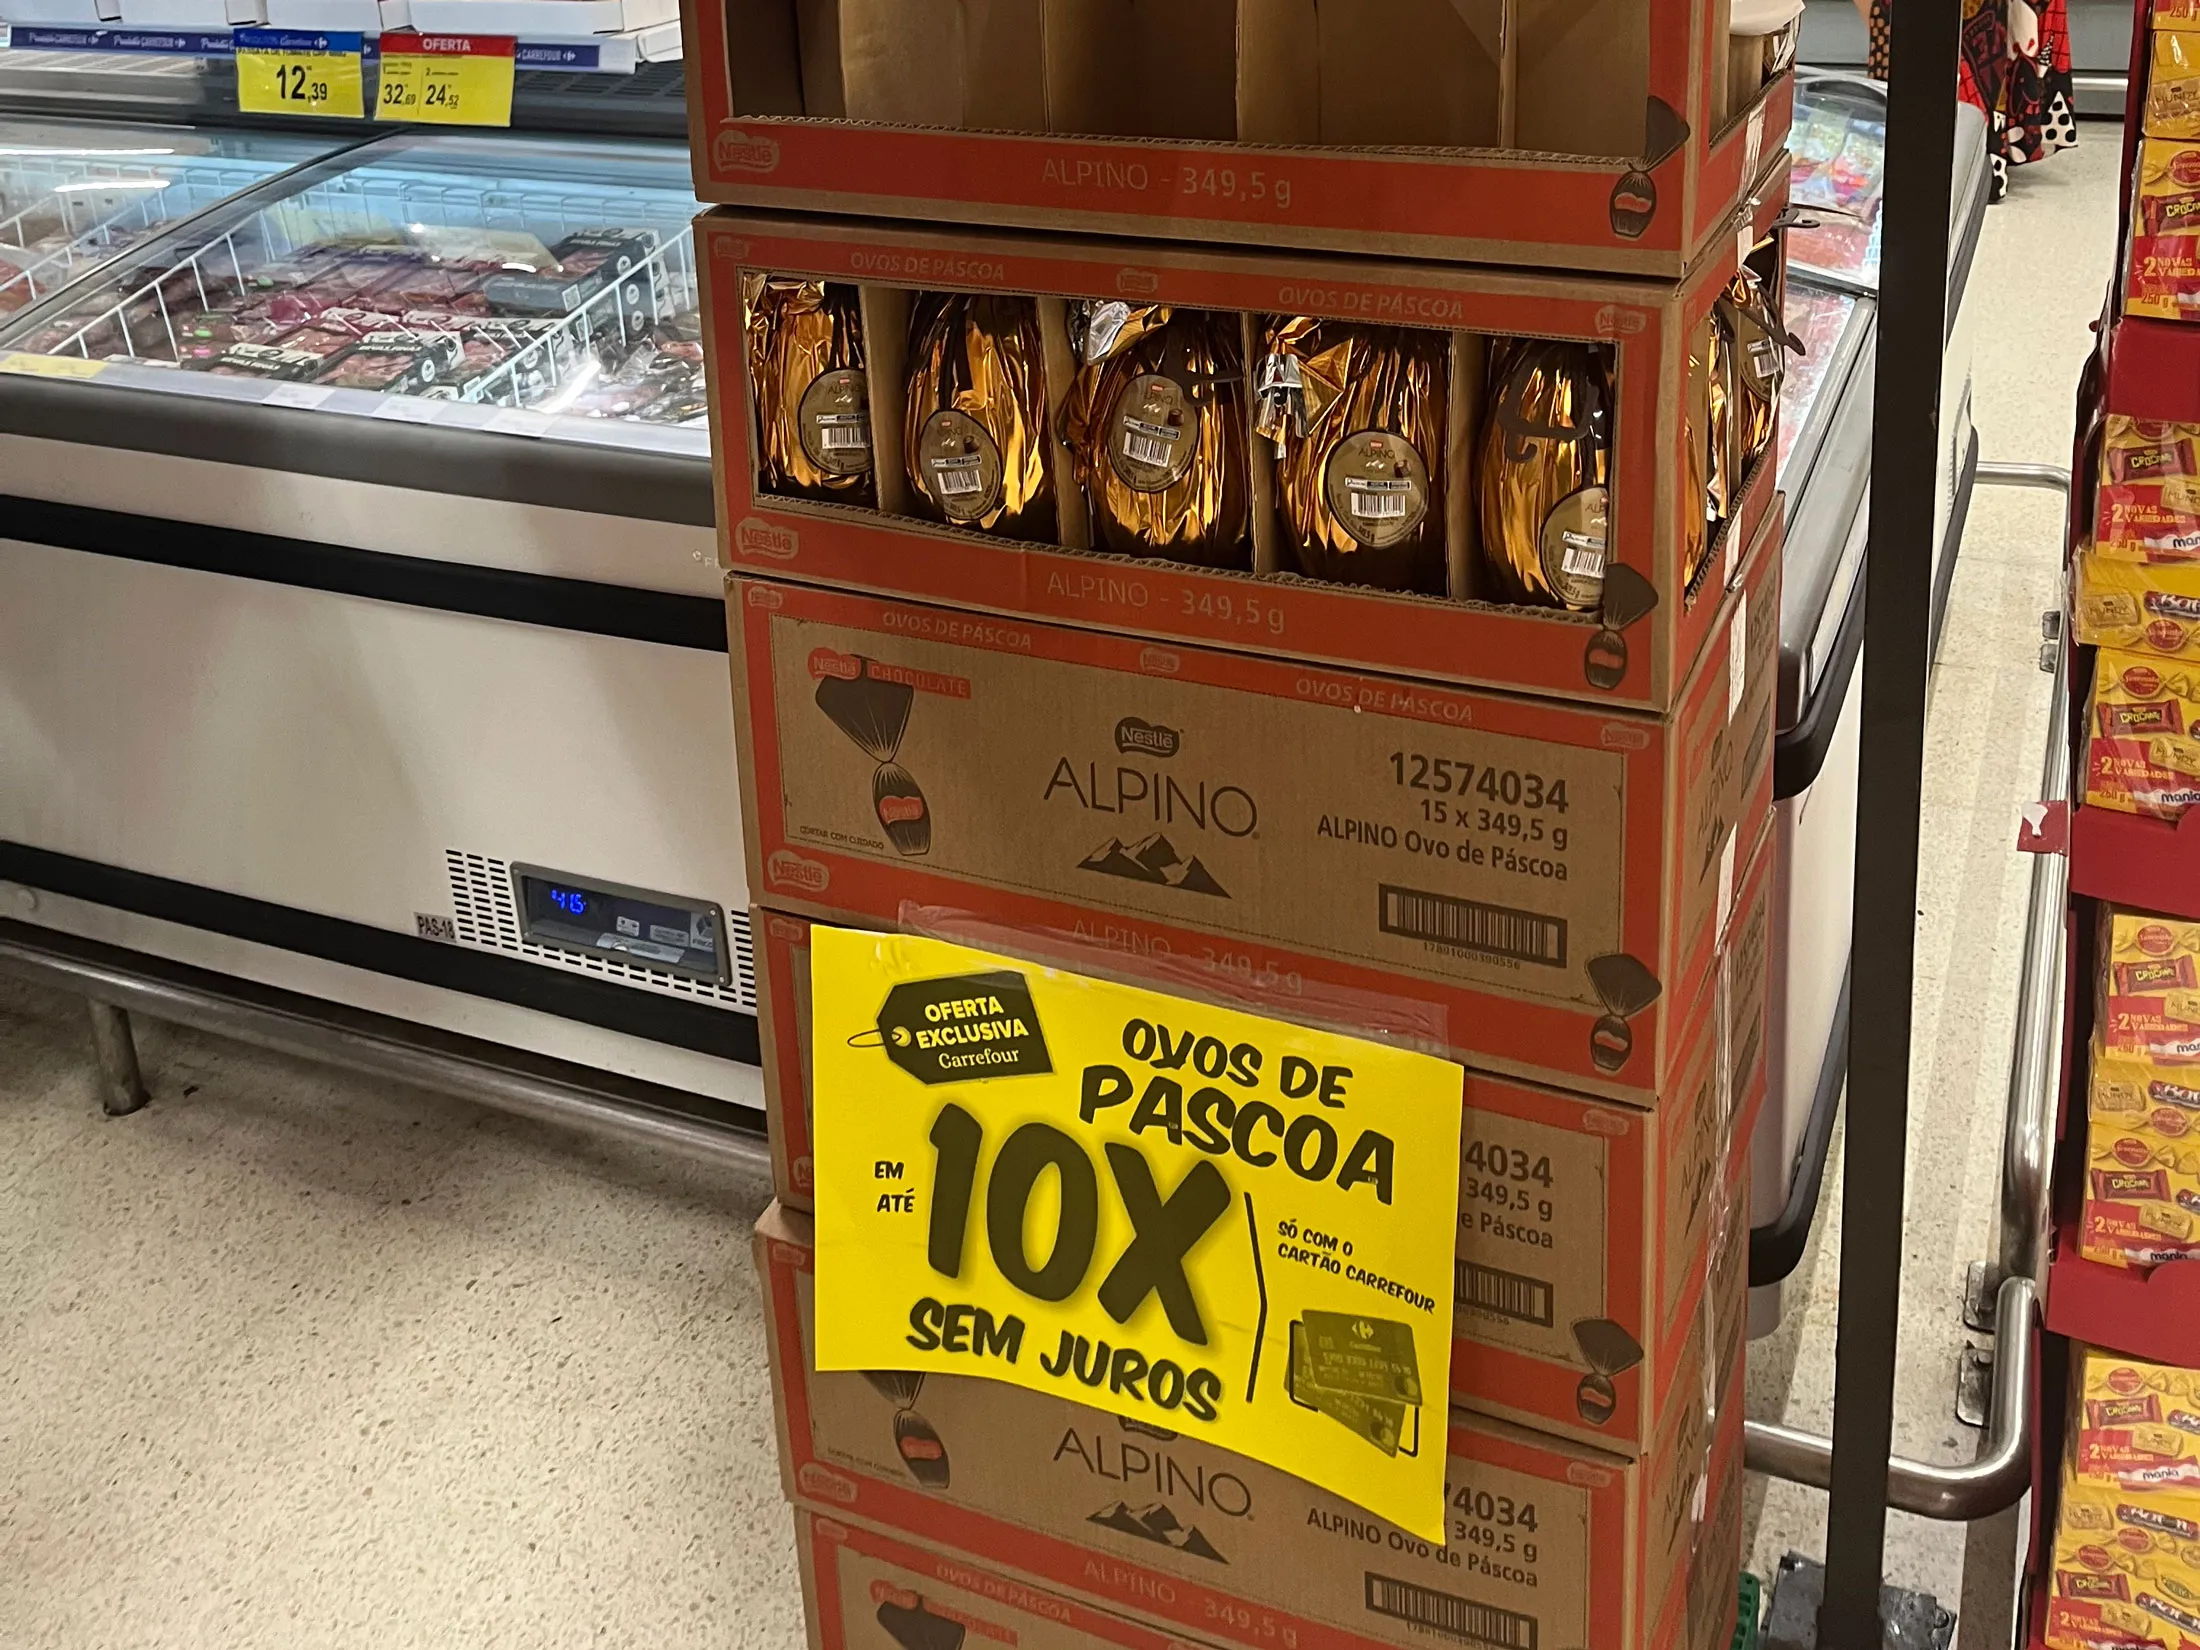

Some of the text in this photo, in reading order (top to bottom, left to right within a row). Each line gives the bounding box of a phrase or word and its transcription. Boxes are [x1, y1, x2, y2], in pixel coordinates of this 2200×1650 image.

[423, 39, 471, 51] OFERTA
[1042, 158, 1148, 190] ALPINO
[1182, 167, 1265, 201] 349,5
[1275, 178, 1291, 208] g
[850, 251, 900, 273] OVOS
[906, 256, 929, 275] DE
[2143, 256, 2157, 277] 2
[1278, 286, 1337, 307] OVOS
[1343, 292, 1373, 312] DE
[2112, 504, 2124, 522] 2
[1047, 571, 1149, 607] ALPINO
[1181, 589, 1261, 626] 349,5
[1269, 604, 1285, 634] g
[883, 610, 1032, 649] OVOS DE PÁSCOA
[870, 664, 967, 694] CHOCOLATE
[1296, 677, 1352, 701] OVOS
[1359, 686, 1385, 708] DE
[1390, 752, 1569, 813] 12574034
[2101, 756, 2114, 775] 2
[1044, 755, 1257, 838] ALPINO
[1421, 799, 1568, 851] 15 x 349,5 g
[1317, 815, 1568, 881] ALPINO Ovo de Páscoa
[924, 996, 1004, 1022] OFERTA
[2118, 1013, 2131, 1030] 2
[917, 1017, 1028, 1050] EXCLUSIVA
[938, 1045, 1020, 1070] Carrefour
[1122, 1018, 1354, 1109] OVOS DE
[1079, 1064, 1395, 1206] PASCOA
[875, 1161, 904, 1180] EM
[1461, 1139, 1554, 1188] 4034
[876, 1189, 915, 1214] ATÉ
[1466, 1178, 1553, 1222] 349,5 g
[928, 1102, 1232, 1346] 10X
[1277, 1218, 1353, 1257] SÓ COM O
[1481, 1212, 1553, 1249] Páscoa
[2095, 1216, 2106, 1233] 2
[1277, 1243, 1436, 1314] CARTÃO CARREFOUR
[905, 1297, 1222, 1421] SEM JUROS
[2089, 1443, 2101, 1460] 2
[1053, 1427, 1252, 1517] ALPINO
[2142, 1467, 2179, 1481] mania
[1445, 1484, 1539, 1533] 4034
[1307, 1507, 1539, 1587] ALPINO Ovo de Páscoa
[1454, 1520, 1538, 1563] 349,5 g
[1084, 1559, 1177, 1604] ALPINO
[1204, 1599, 1276, 1639] 349,5
